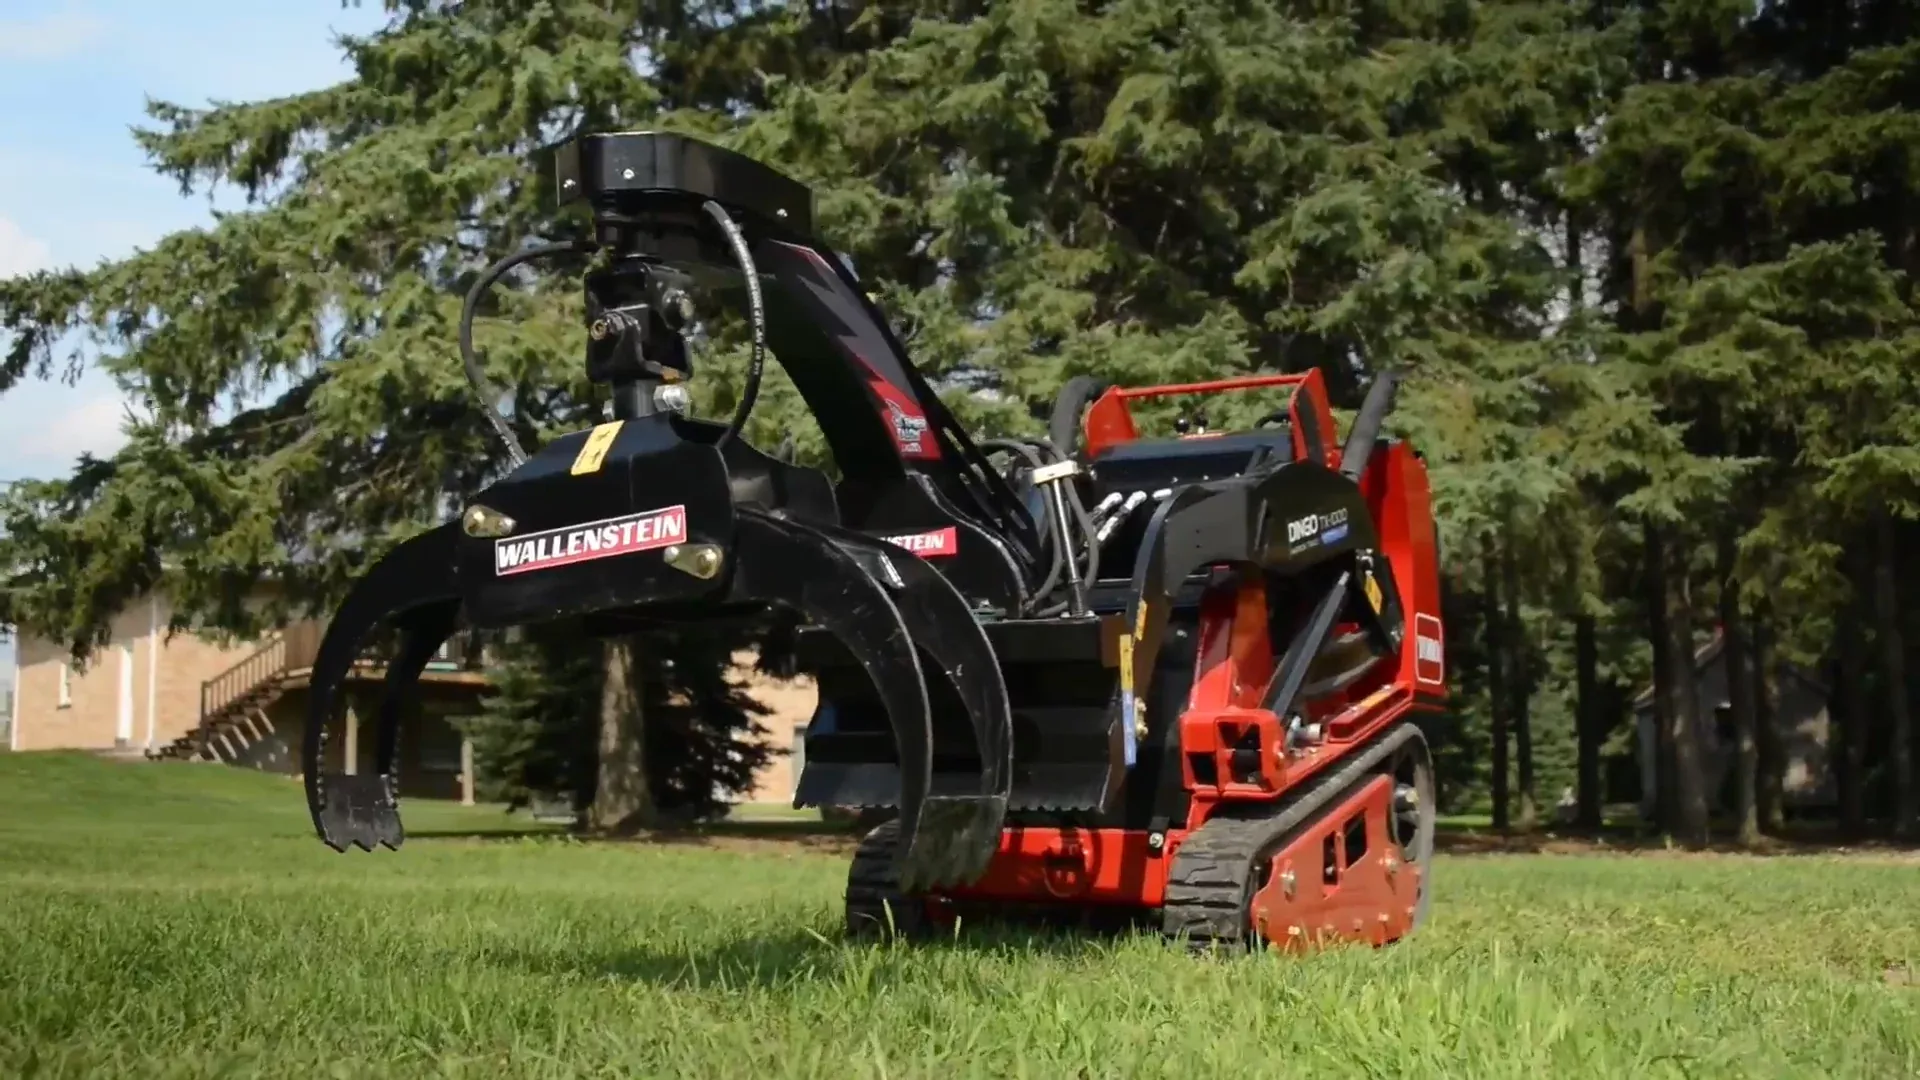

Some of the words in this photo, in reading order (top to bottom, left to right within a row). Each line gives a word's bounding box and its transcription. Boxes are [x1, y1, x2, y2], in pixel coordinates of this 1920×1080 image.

[499, 513, 682, 568] WALLENSTEIN
[879, 533, 945, 551] STEIN
[1288, 514, 1318, 542] DINGO
